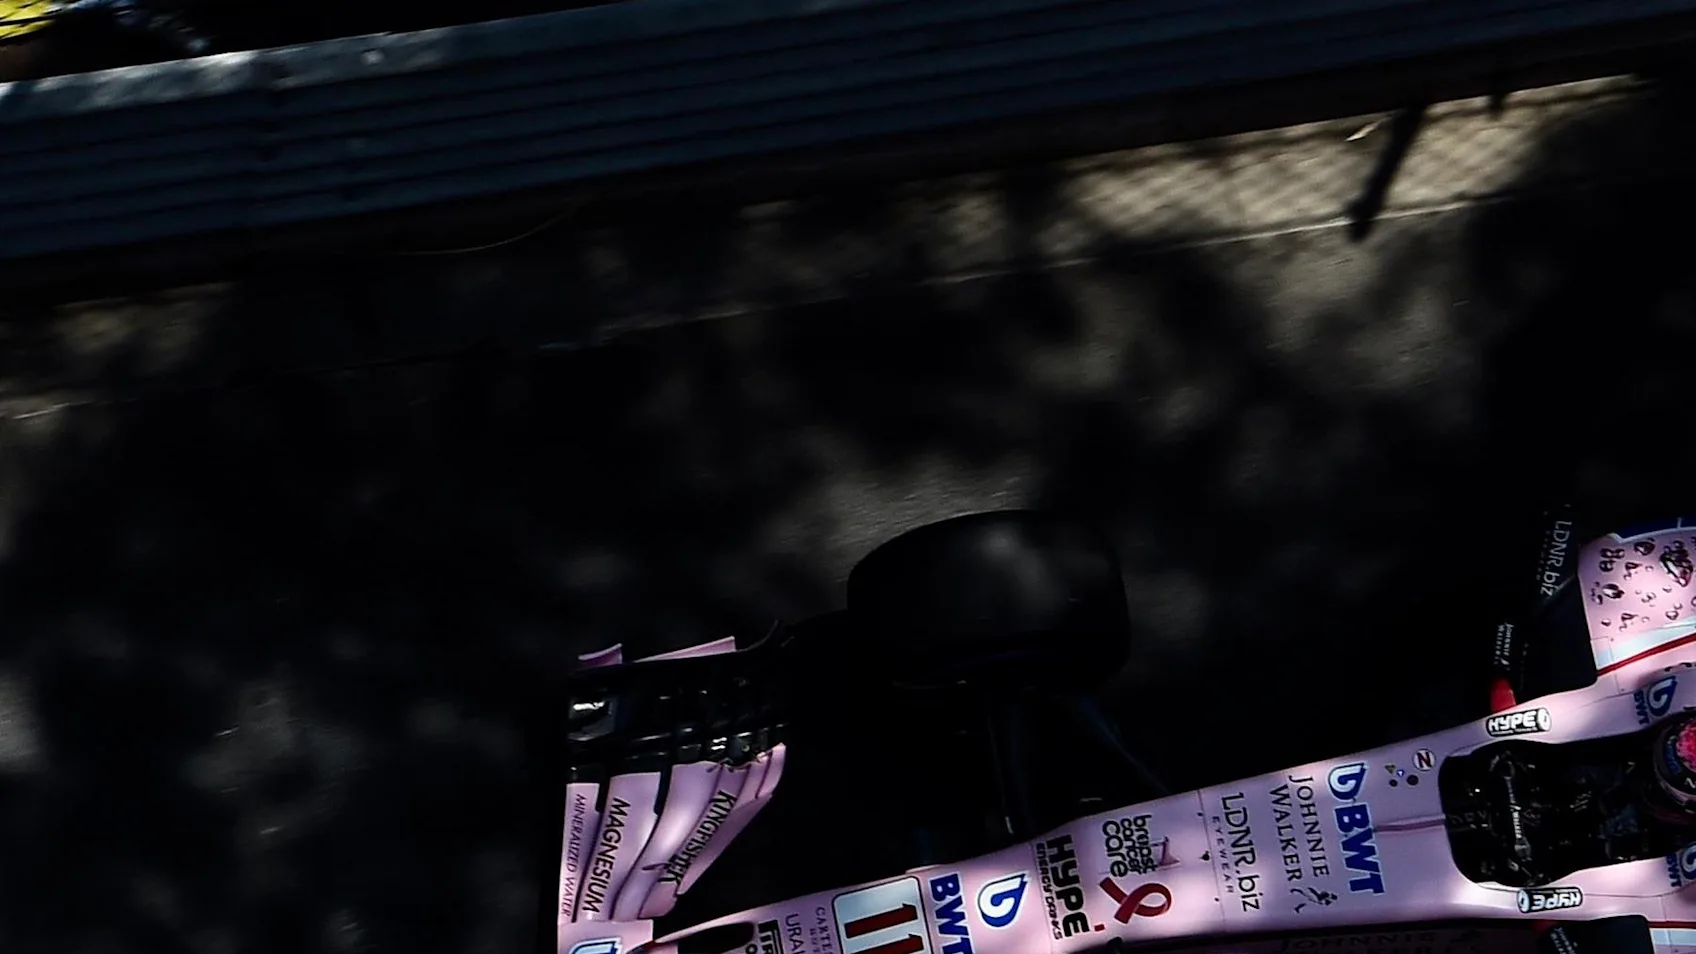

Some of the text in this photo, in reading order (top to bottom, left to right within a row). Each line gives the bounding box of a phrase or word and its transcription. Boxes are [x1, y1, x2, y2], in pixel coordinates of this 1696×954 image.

[1488, 710, 1537, 731] HYPE
[563, 793, 587, 917] MINERALIZED WATER
[582, 797, 631, 914] MAGNESIUM
[659, 790, 737, 886] KINGFISHER
[1102, 820, 1128, 877] care
[1221, 791, 1263, 912] LDNR.biz
[1269, 784, 1303, 882] WALKER
[1289, 775, 1330, 878] JOHNNIE
[1334, 804, 1385, 894] BWT
[1046, 834, 1091, 938] HYPE
[1534, 891, 1580, 909] HYPE
